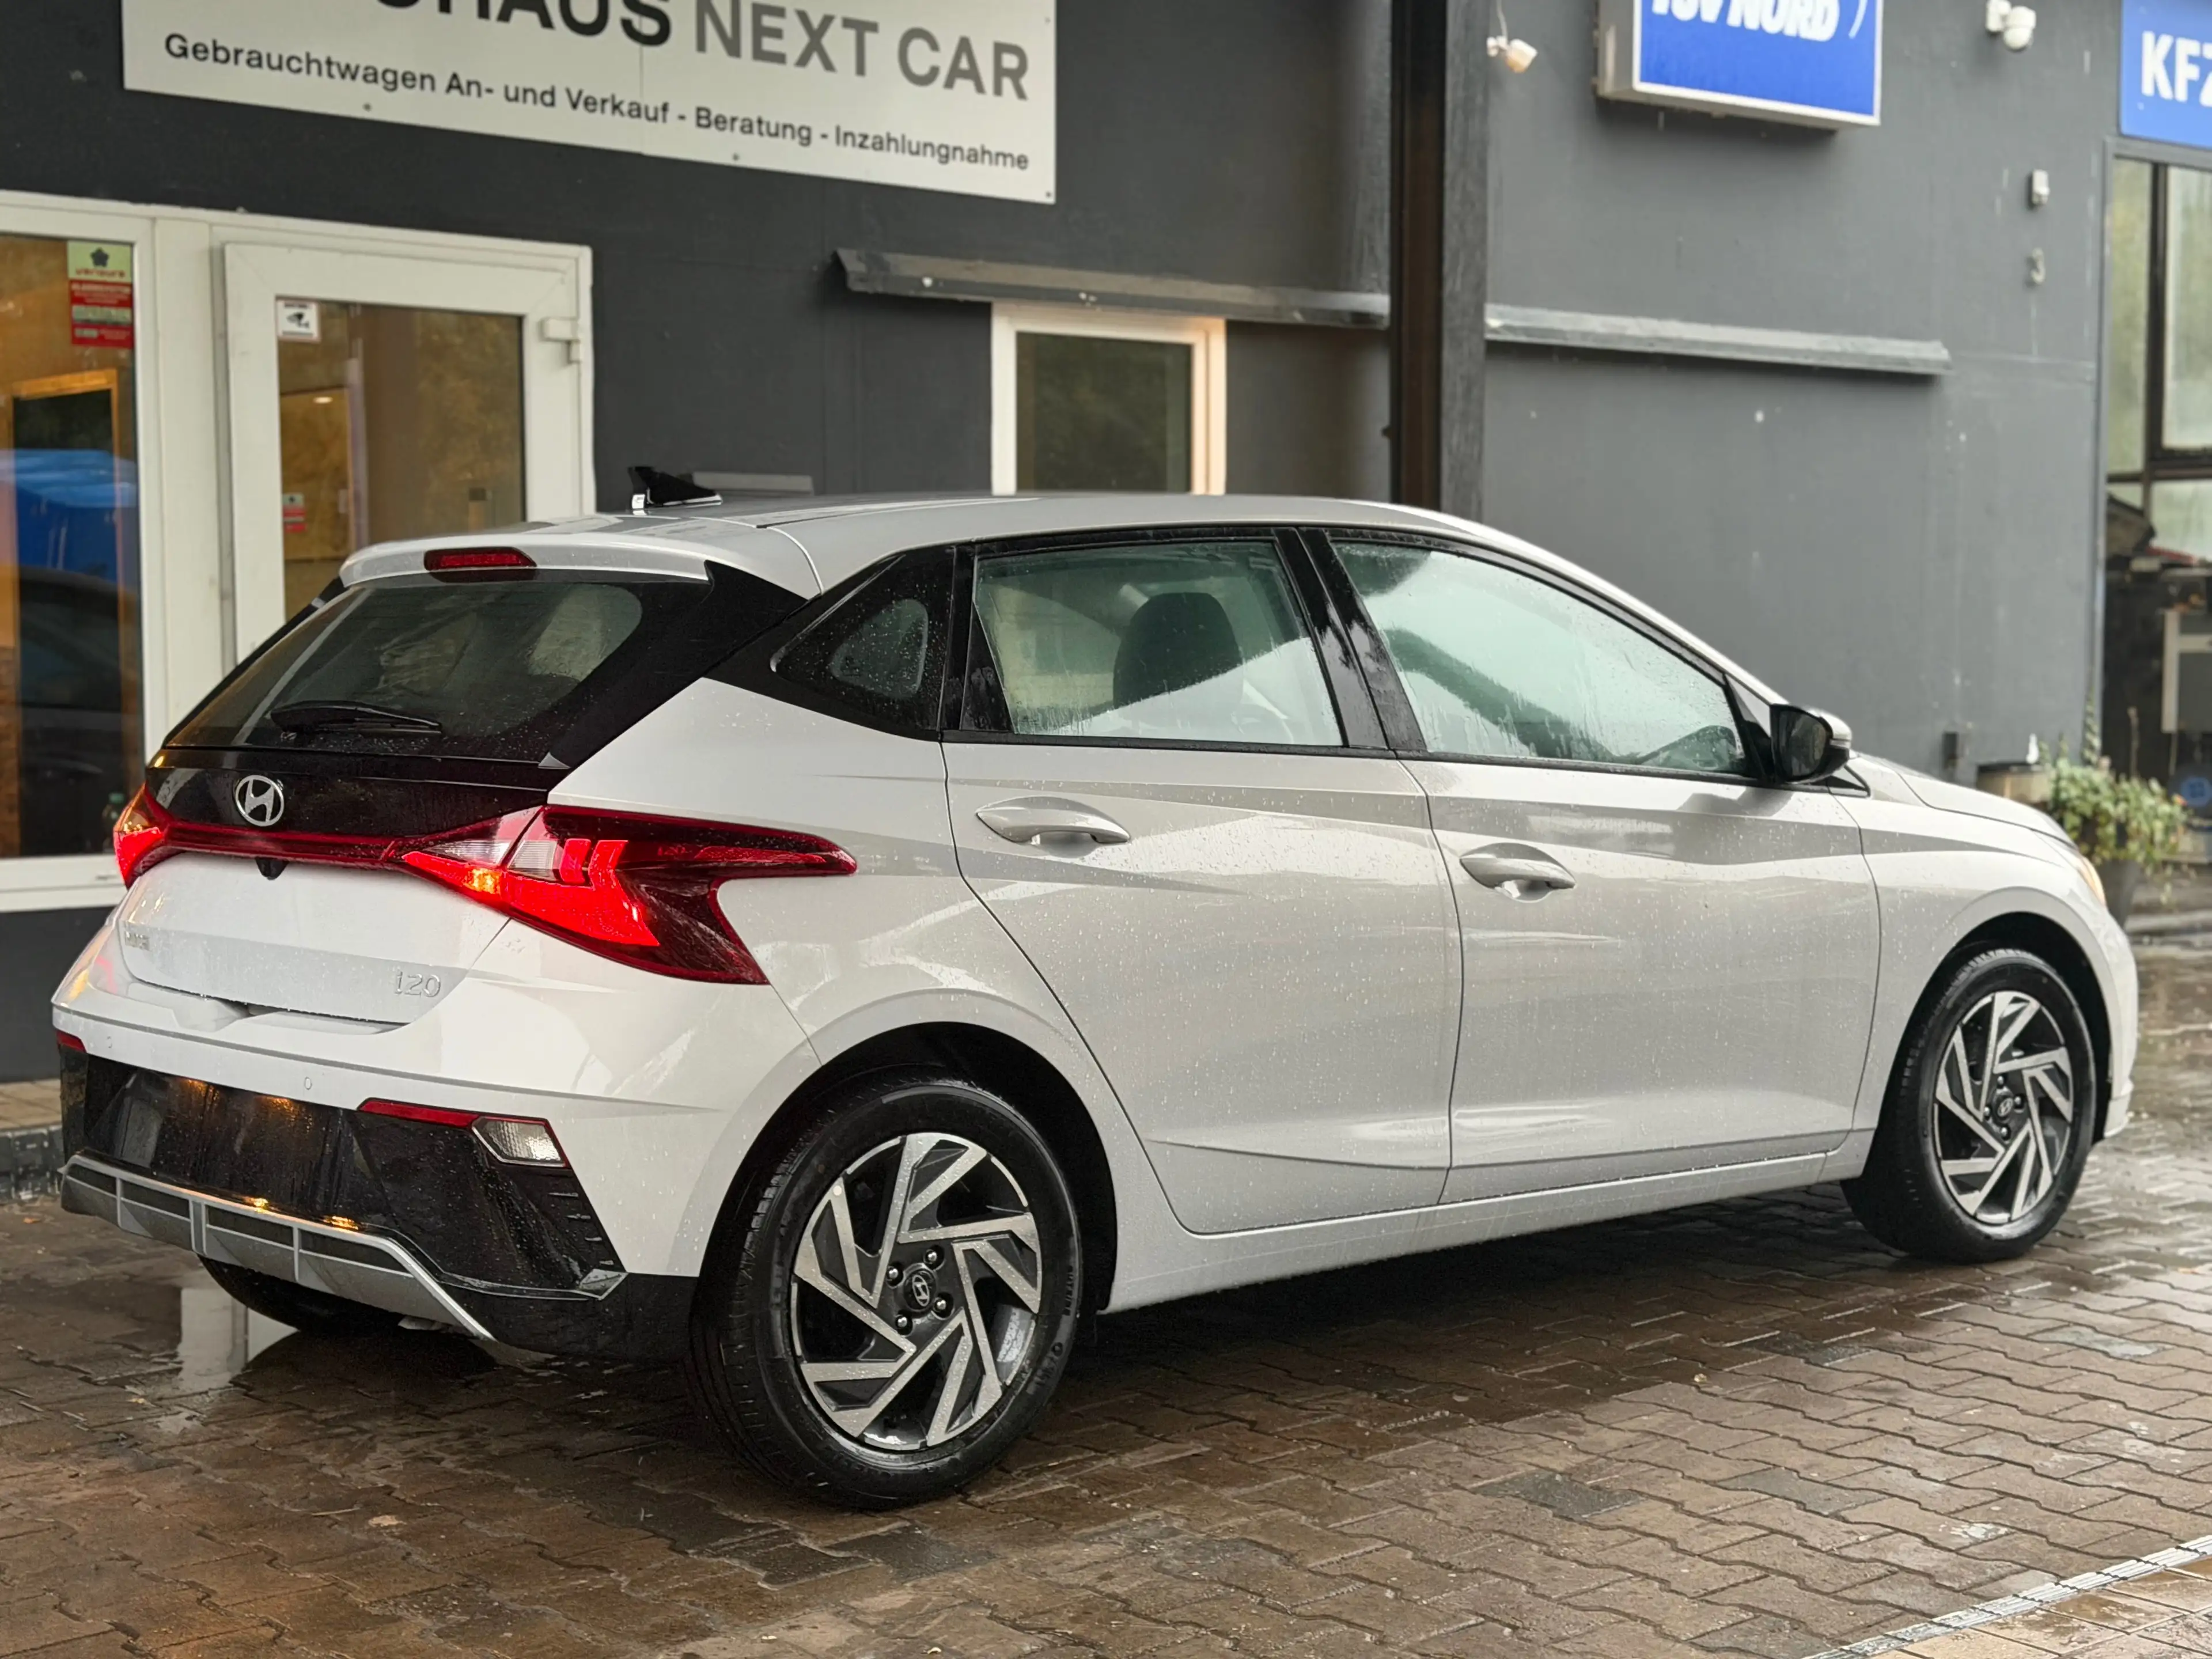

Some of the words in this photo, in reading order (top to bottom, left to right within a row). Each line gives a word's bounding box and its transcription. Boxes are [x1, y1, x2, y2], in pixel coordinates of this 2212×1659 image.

[165, 33, 436, 93] Gebrauchtwagen
[445, 72, 494, 99] An-
[504, 85, 556, 108] und
[565, 88, 669, 124] Verkauf
[695, 107, 812, 147] Beratung
[835, 125, 1029, 171] Inzahlungnahme
[696, 0, 878, 77] NEXT
[898, 27, 1029, 101] CAR
